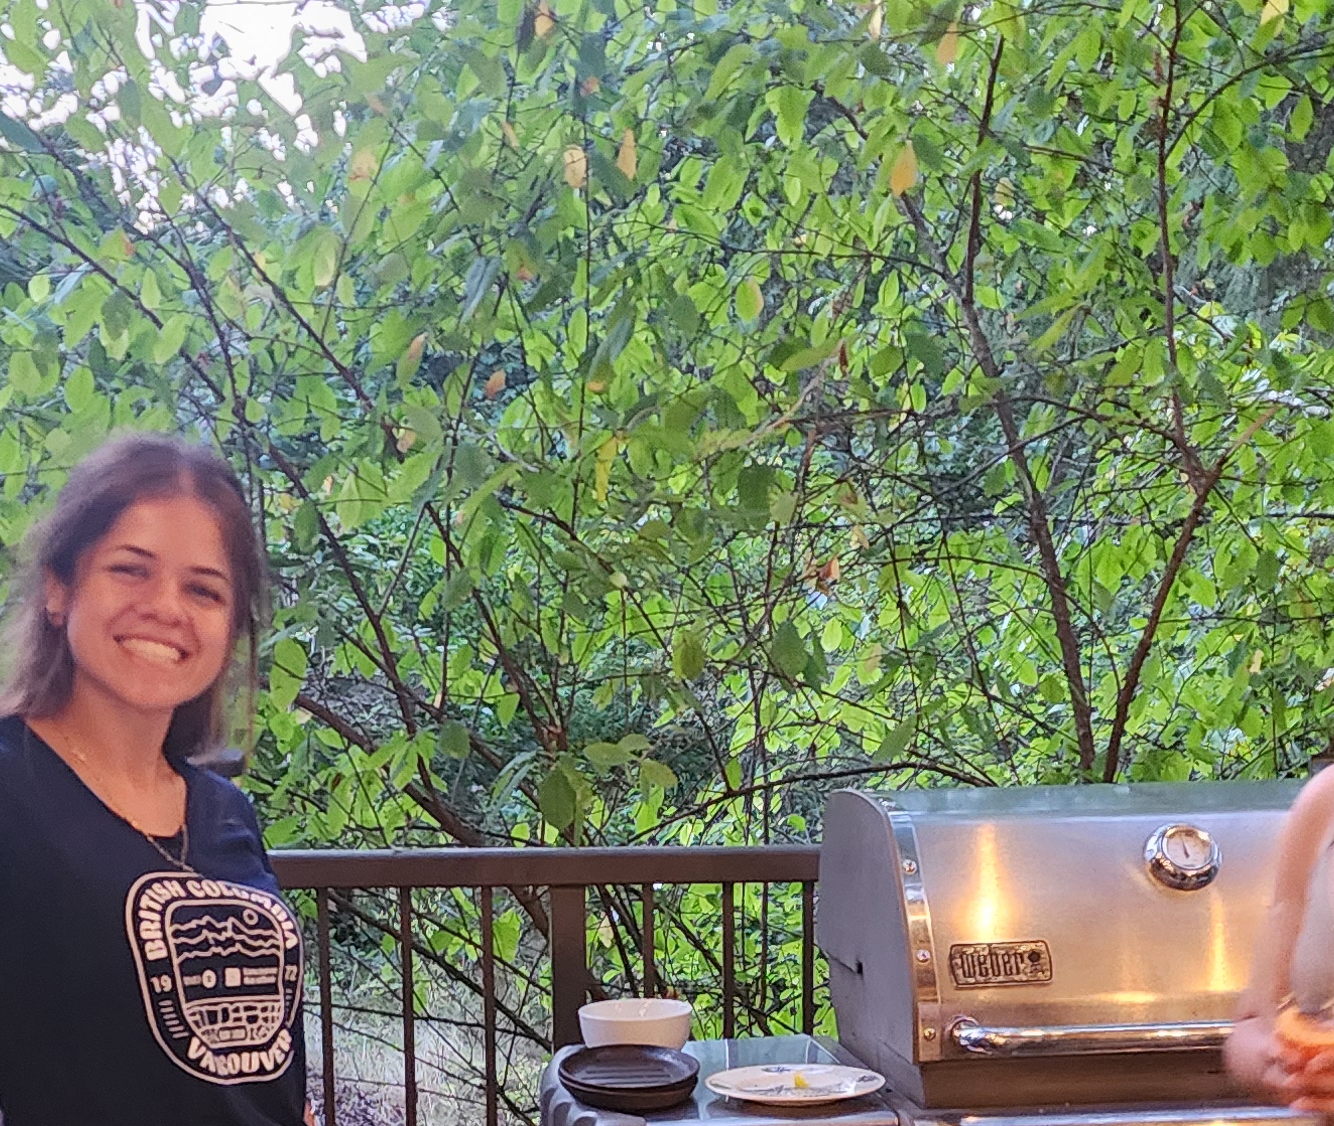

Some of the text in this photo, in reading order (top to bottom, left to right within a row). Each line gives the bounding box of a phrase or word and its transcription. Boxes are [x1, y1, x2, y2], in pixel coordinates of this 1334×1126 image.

[138, 879, 187, 961] BRITISH
[150, 974, 172, 993] 19
[187, 1028, 293, 1076] VAOUVER
